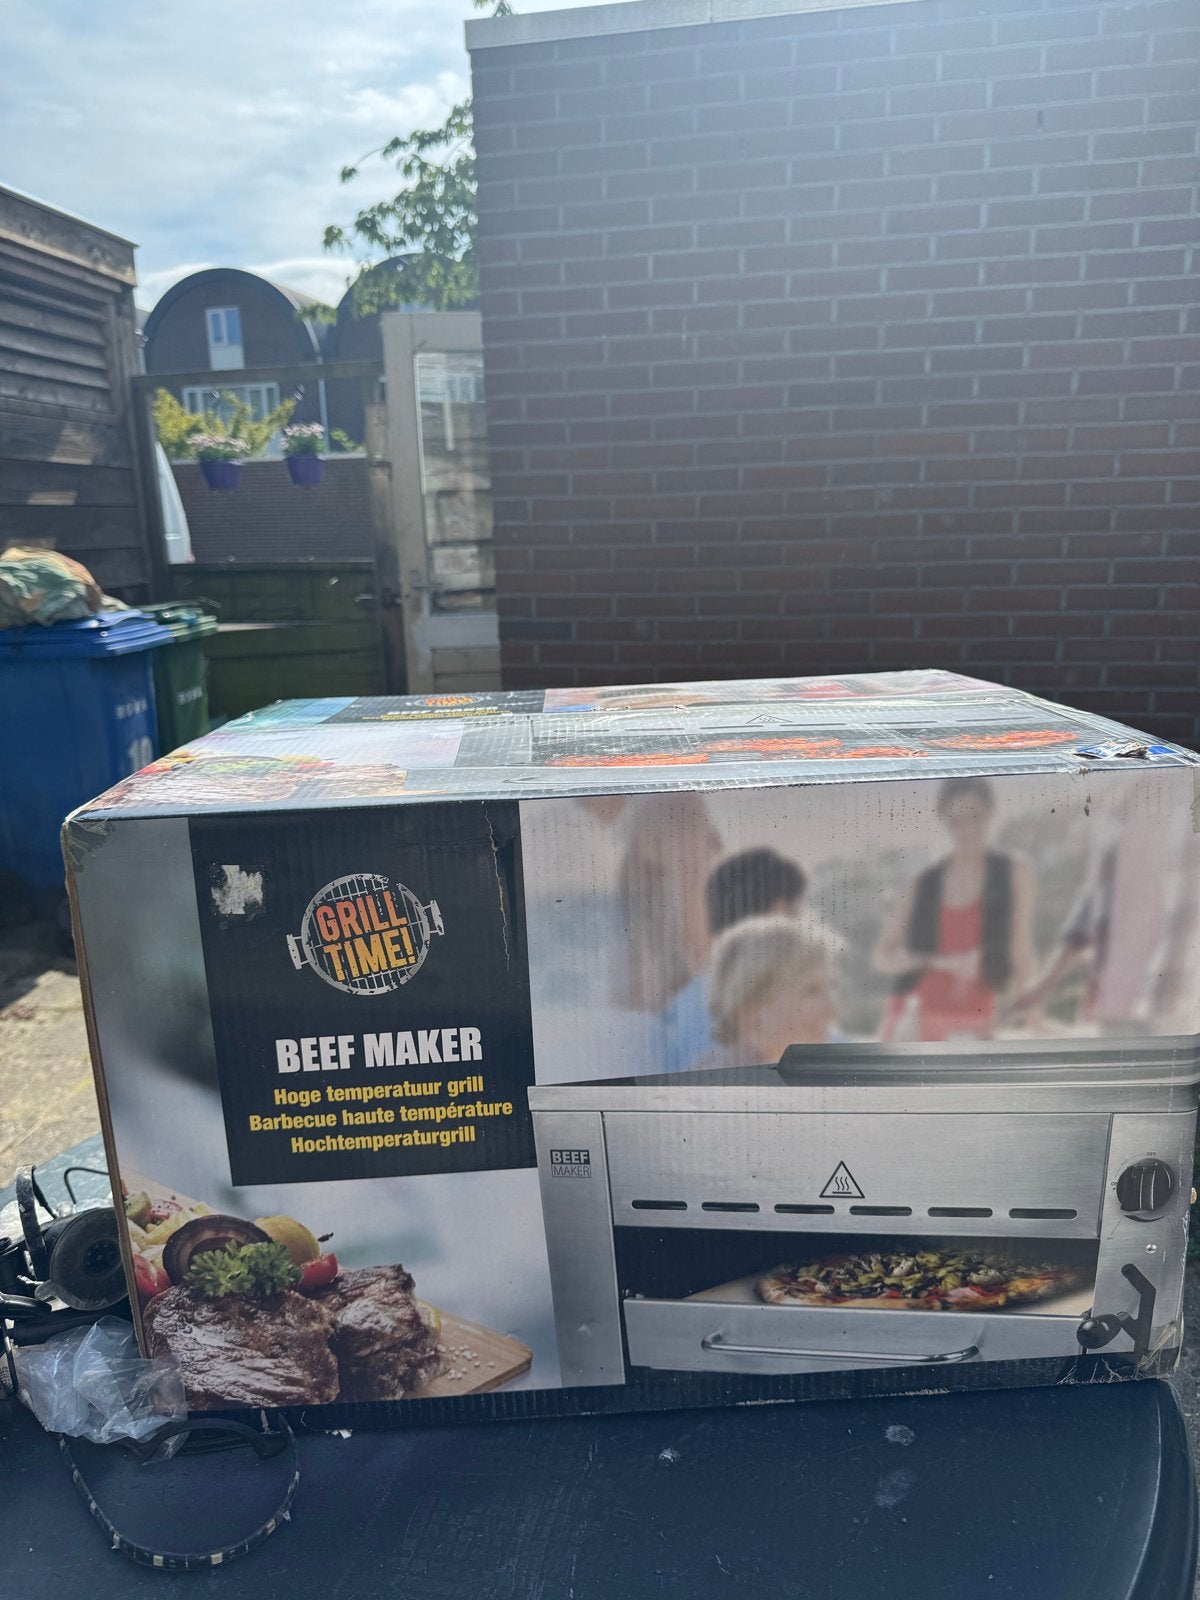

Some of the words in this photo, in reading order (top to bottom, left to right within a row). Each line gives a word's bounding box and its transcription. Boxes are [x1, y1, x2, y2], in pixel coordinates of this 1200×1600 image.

[316, 891, 407, 942] GRILL
[324, 927, 416, 982] TIME!
[275, 1035, 355, 1073] BEEF
[363, 1027, 483, 1068] MAKER
[274, 1087, 321, 1106] Hoge
[326, 1081, 441, 1103] temperatuur
[447, 1075, 484, 1096] grill
[249, 1112, 337, 1131] Barbecue
[342, 1107, 395, 1125] haute
[400, 1100, 513, 1123] température
[291, 1126, 476, 1153] Hochtemperaturgrill
[552, 1151, 588, 1163] BEEF
[554, 1165, 590, 1176] MAKER
